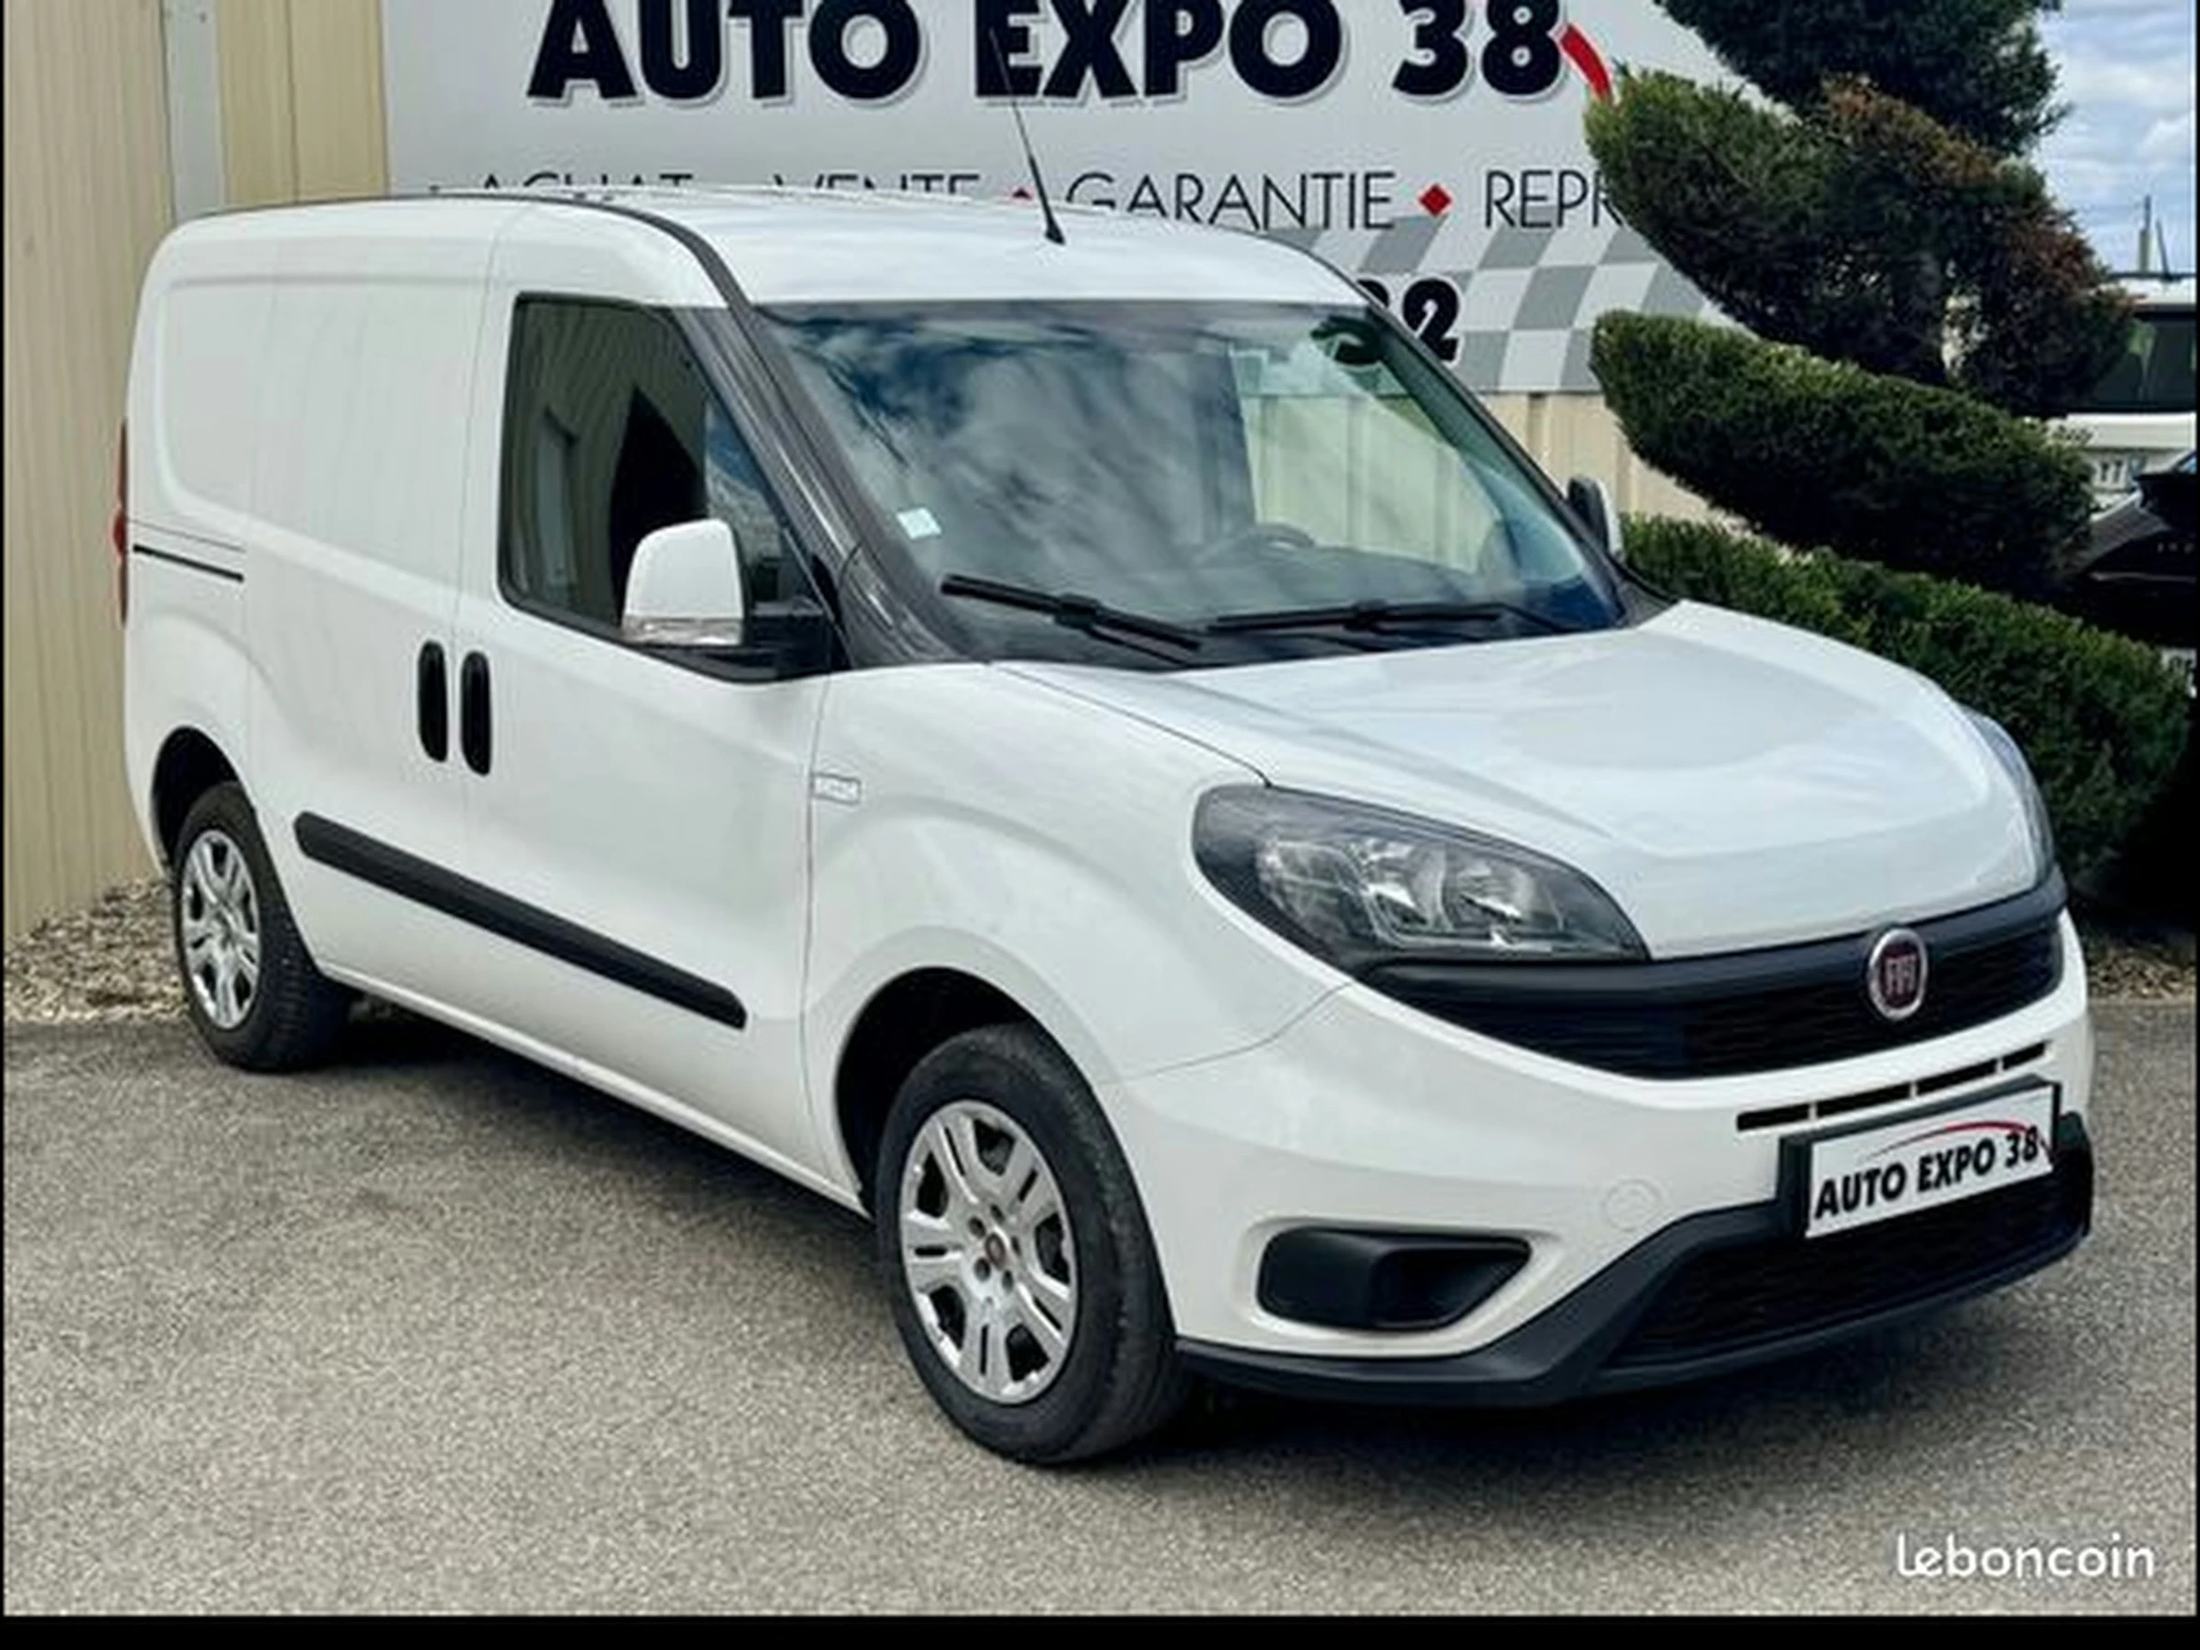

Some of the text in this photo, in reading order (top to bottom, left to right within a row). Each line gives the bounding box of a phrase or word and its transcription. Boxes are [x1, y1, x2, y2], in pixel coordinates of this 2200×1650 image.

[526, 0, 1561, 100] AUTO EXPO 38
[1065, 171, 1395, 231] GARANTIE
[1814, 1125, 2039, 1219] AUTO EXPO 38
